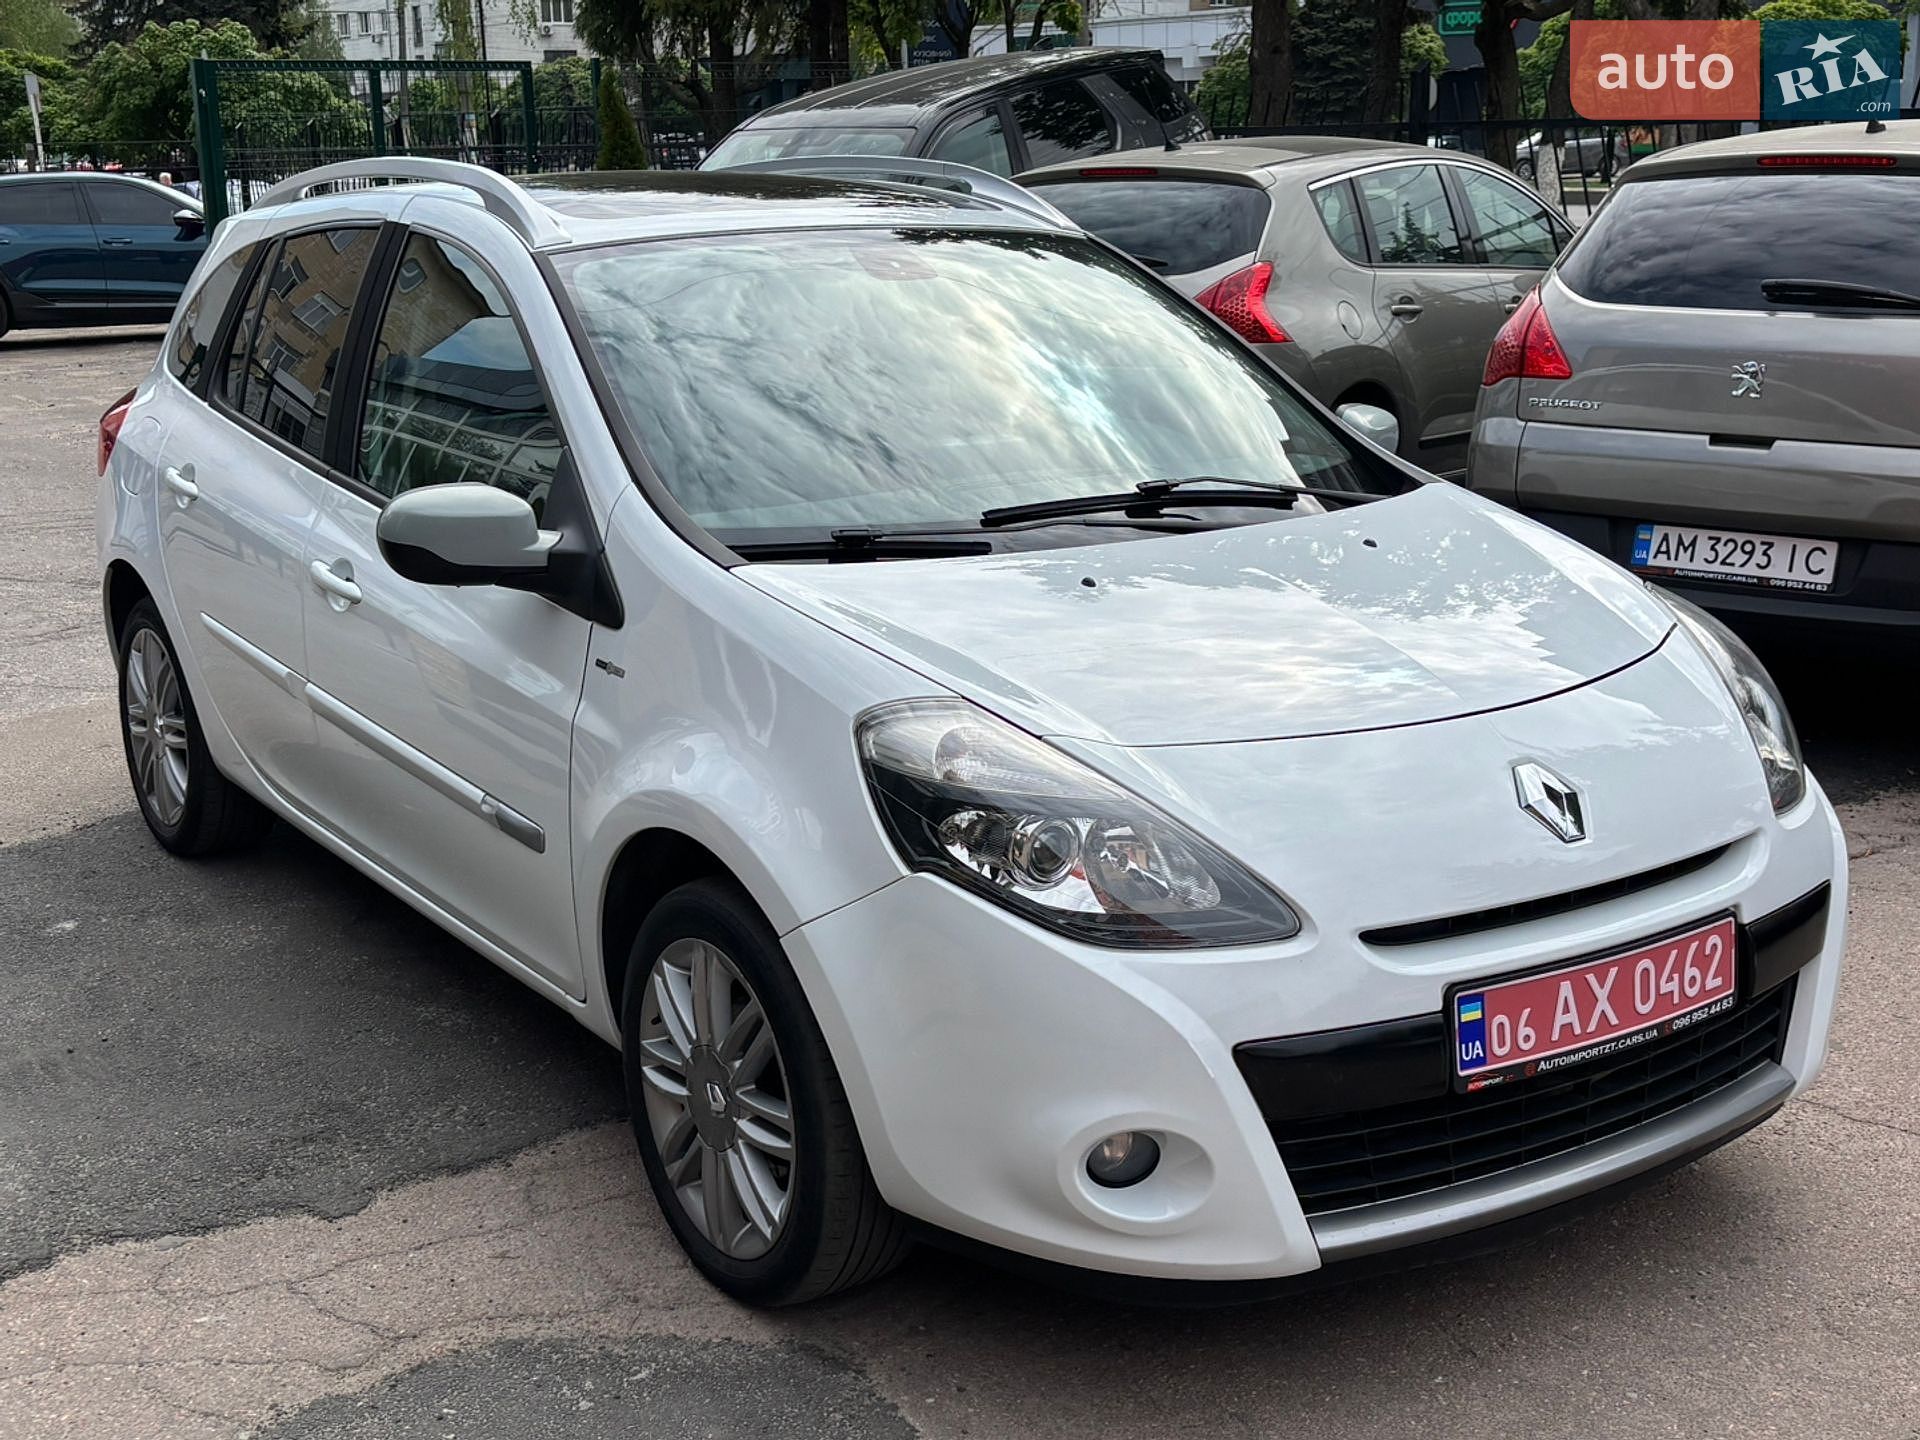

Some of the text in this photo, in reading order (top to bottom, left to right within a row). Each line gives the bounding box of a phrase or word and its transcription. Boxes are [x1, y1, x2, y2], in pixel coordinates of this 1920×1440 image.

[1528, 397, 1602, 411] PEUGEOT
[1634, 549, 1648, 560] UA
[1653, 532, 1699, 563] AM
[1703, 535, 1775, 570] 3293
[1490, 934, 1724, 1058] 06 AX 0462
[1461, 1040, 1485, 1061] UA
[1536, 1028, 1659, 1073] AUTOIMPORTZT.CARS.UA
[1691, 1007, 1709, 1023] 952
